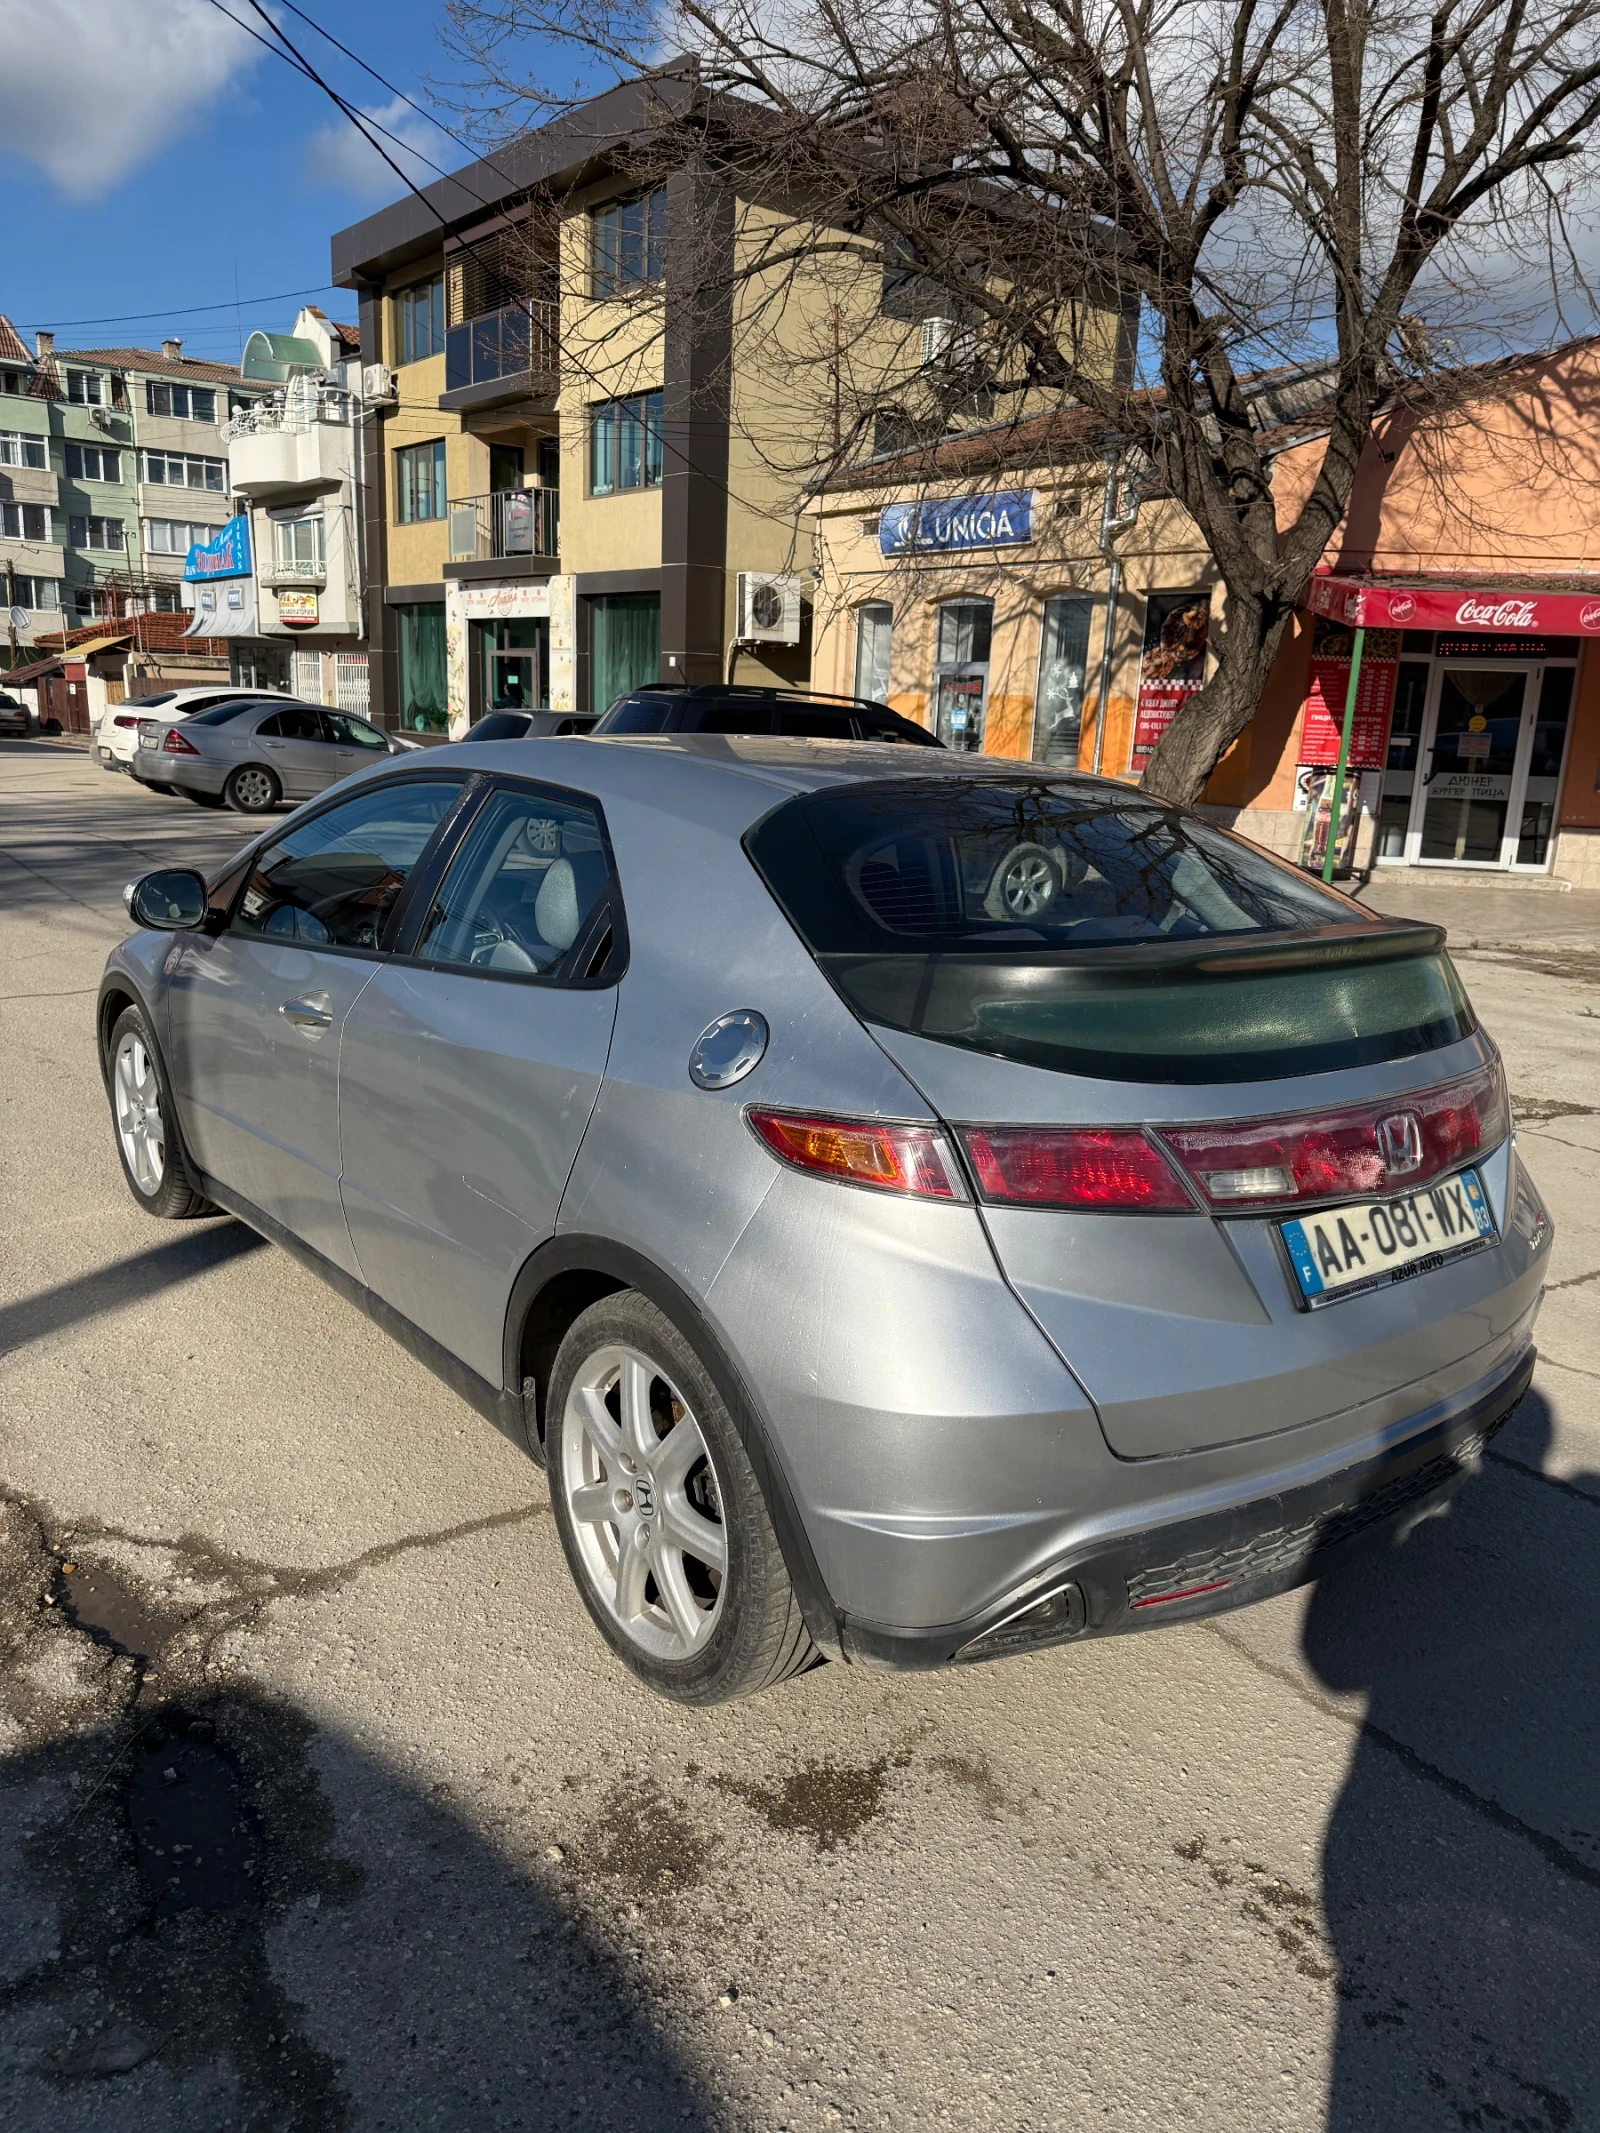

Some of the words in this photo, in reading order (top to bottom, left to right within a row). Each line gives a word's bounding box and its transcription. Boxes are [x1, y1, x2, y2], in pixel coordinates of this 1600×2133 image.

[935, 509, 1015, 543] UNIQA
[1455, 598, 1538, 627] Coca-Cola
[1432, 787, 1466, 796] БУРГЕР
[1472, 788, 1505, 798] ПИЦА
[1448, 776, 1493, 787] ДЮНЕР
[1314, 1183, 1475, 1278] AA-081-WX
[1475, 1206, 1490, 1230] 83
[1302, 1266, 1312, 1283] F
[1391, 1264, 1418, 1284] AZUR
[1420, 1253, 1444, 1273] AUTO
